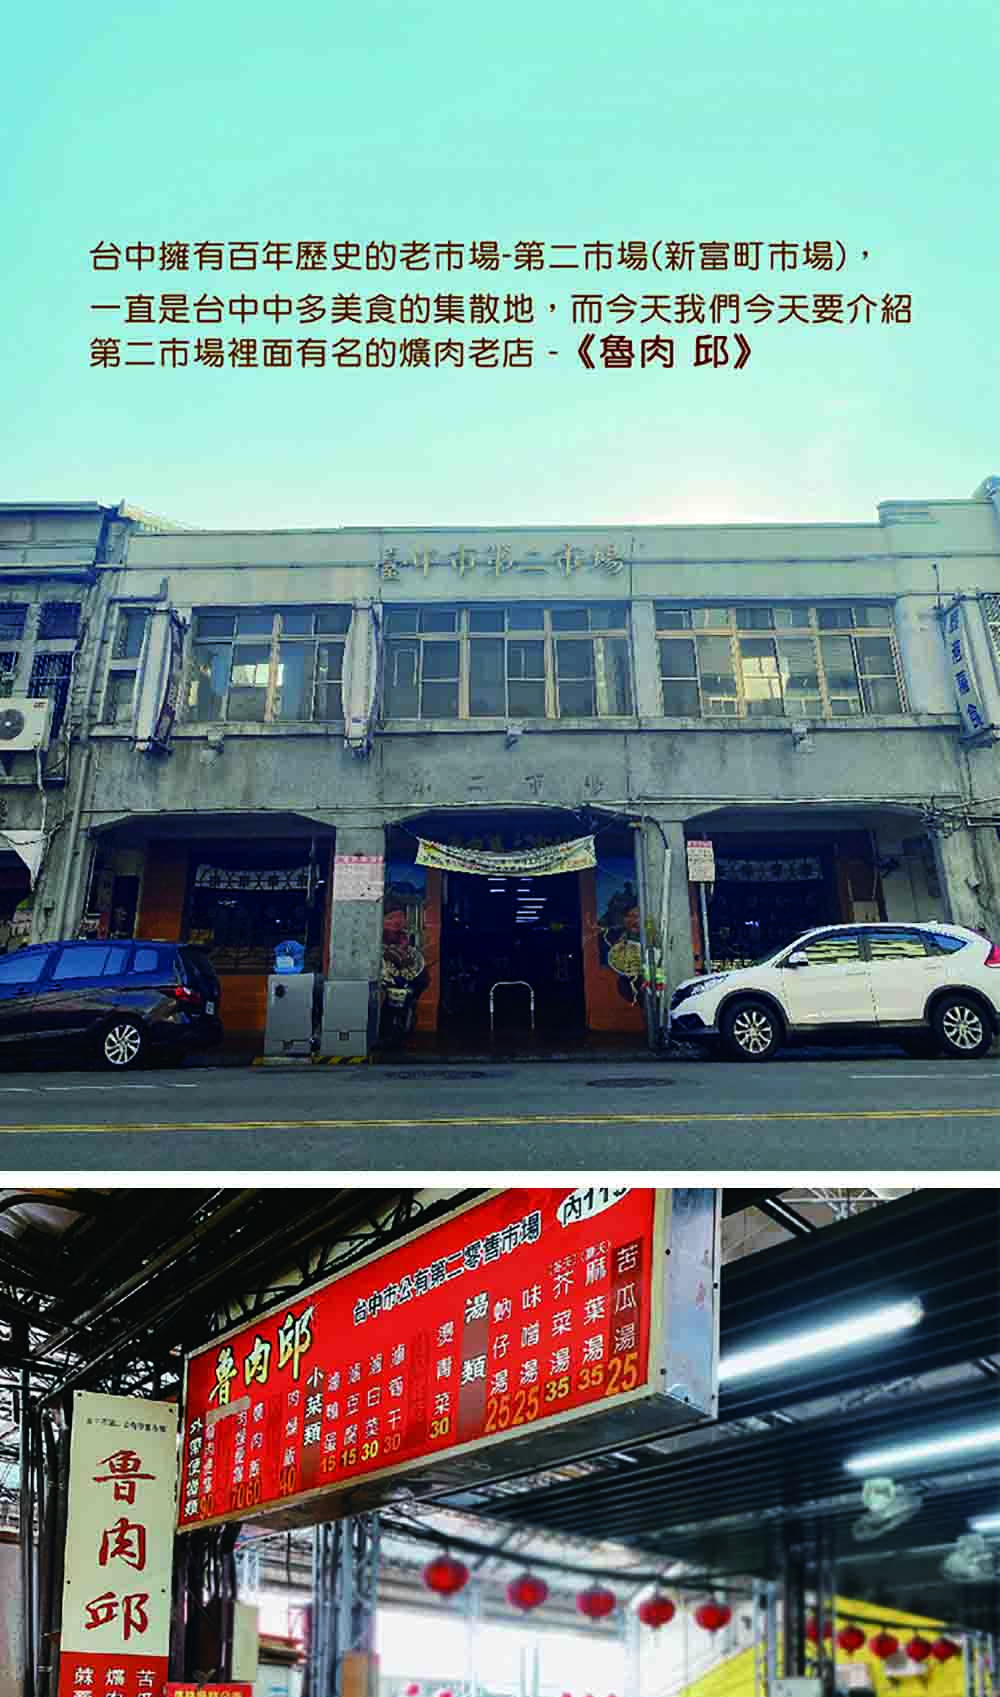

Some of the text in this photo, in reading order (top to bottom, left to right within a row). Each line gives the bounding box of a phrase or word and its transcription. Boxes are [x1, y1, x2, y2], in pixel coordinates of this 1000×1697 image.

[353, 1210, 541, 1326] 台中市公有第二零售市場
[461, 1292, 488, 1386] 湯類
[605, 1244, 639, 1396] 苦瓜湯 25
[208, 1305, 314, 1404] 魯肉邱
[545, 1376, 570, 1402] 35
[578, 1364, 604, 1390] 35
[486, 1395, 510, 1433] 25
[512, 1386, 539, 1425] 25
[383, 1433, 401, 1454] 30
[429, 1417, 449, 1438] 30
[341, 1448, 357, 1467] 15
[361, 1439, 379, 1460] 30
[85, 1450, 156, 1640] 魯肉邱
